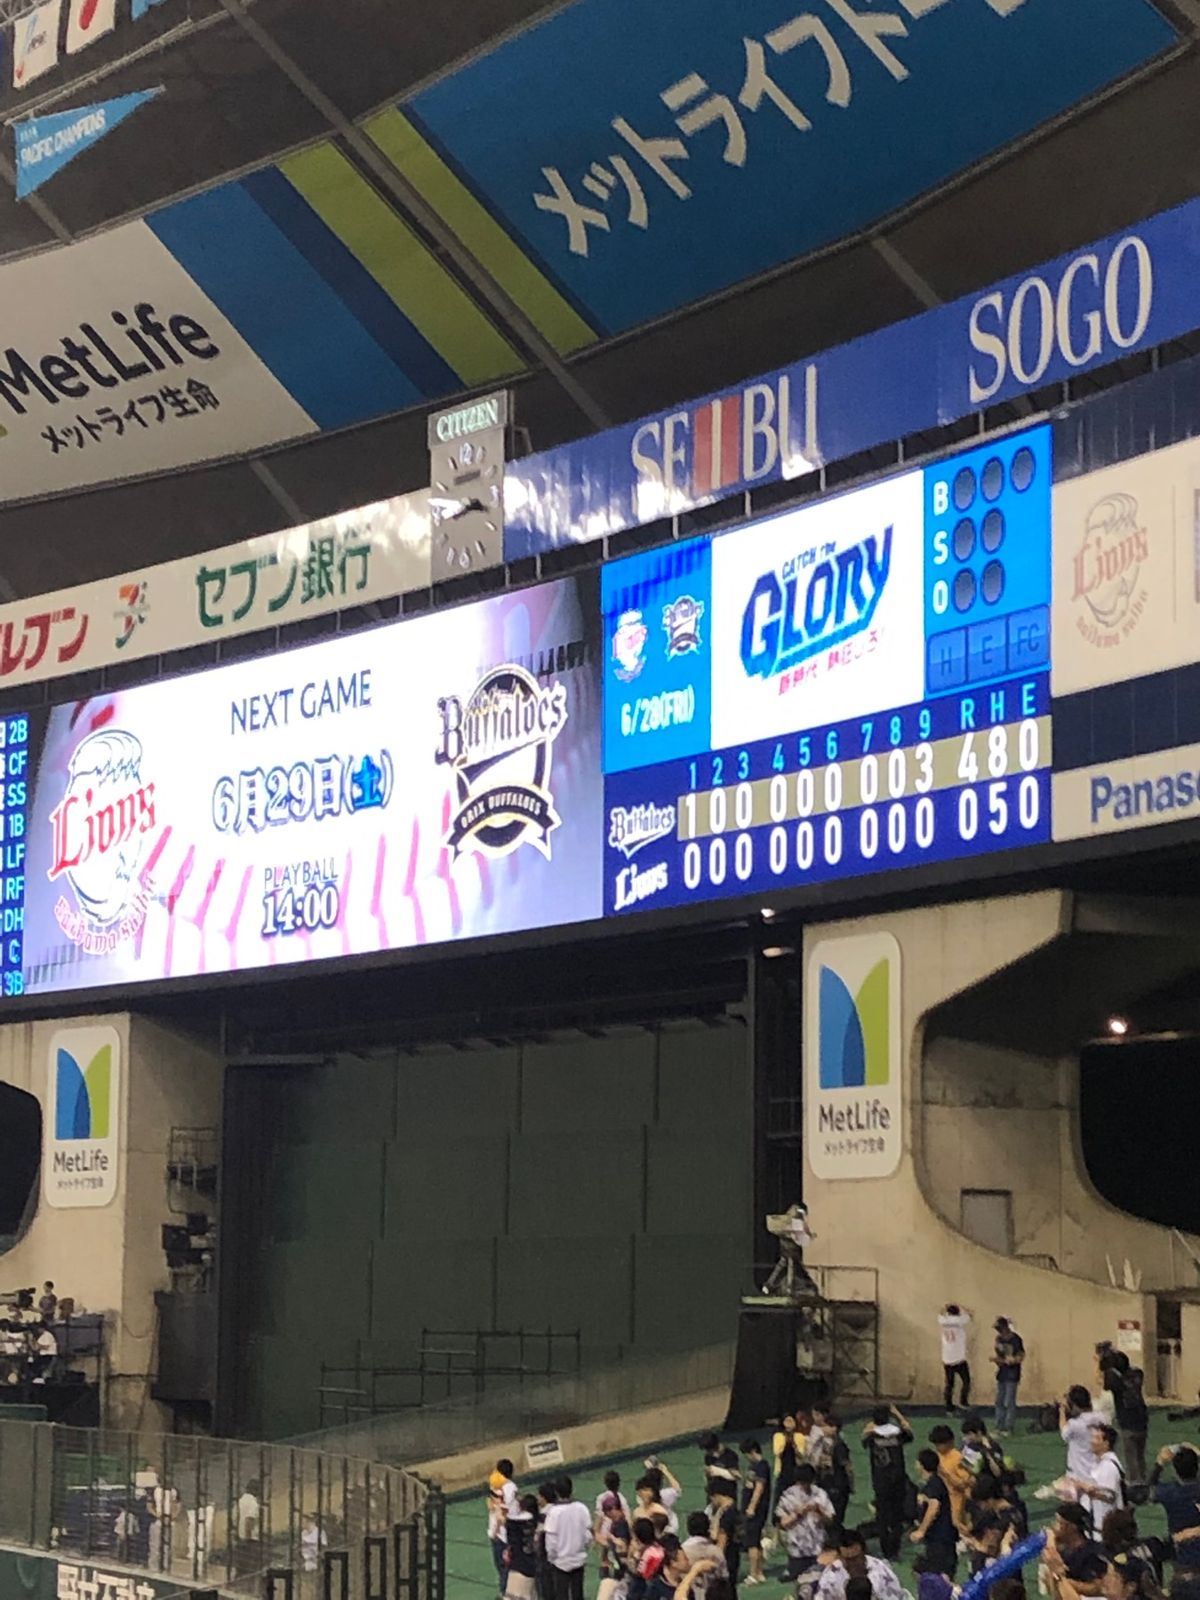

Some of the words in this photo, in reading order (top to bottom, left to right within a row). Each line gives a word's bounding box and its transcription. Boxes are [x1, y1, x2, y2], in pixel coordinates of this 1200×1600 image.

[969, 236, 1153, 403] SOGO
[0, 303, 220, 414] MetLife
[40, 378, 220, 454] メットライフ生命
[436, 399, 499, 442] CITIZEN
[631, 364, 819, 514] SEIBU
[933, 480, 949, 516] B
[933, 530, 949, 565] S
[195, 523, 372, 628] セブン銀行
[739, 523, 894, 680] GLORY
[933, 579, 949, 615] O
[0, 607, 89, 675] レブン
[1017, 622, 1041, 657] FC
[231, 687, 294, 735] NEXT
[300, 669, 372, 719] GAME
[435, 680, 566, 766] Buffaloes
[9, 718, 28, 745] 2B
[689, 762, 697, 790] 1
[712, 757, 723, 785] 2
[737, 751, 749, 779] 3
[772, 743, 785, 772] 4
[799, 737, 810, 766] 5
[826, 730, 838, 760] 6
[861, 722, 873, 752] 7
[890, 715, 901, 745] 8
[919, 708, 931, 739] 9
[961, 698, 975, 730] R
[990, 690, 1005, 723] H
[1022, 682, 1036, 715] E
[9, 750, 28, 776] CF
[685, 793, 696, 839] 1
[709, 787, 726, 834] 0
[736, 781, 753, 829] 0
[770, 775, 787, 822] 0
[797, 769, 814, 817] 0
[825, 763, 842, 812] 0
[860, 754, 878, 804] 0
[888, 748, 906, 799] 0
[915, 742, 933, 793] 3
[958, 732, 978, 783] 4
[988, 725, 1008, 778] 8
[1019, 718, 1039, 771] 0
[8, 782, 26, 805] SS
[212, 749, 394, 836] 6月29日(土)
[1091, 769, 1200, 823] Panas
[9, 813, 25, 837] 1B
[50, 782, 156, 878] Lions
[684, 843, 700, 889] 0
[709, 838, 726, 885] 0
[735, 833, 753, 880] 0
[770, 826, 787, 875] 0
[797, 821, 814, 869] 0
[824, 816, 842, 865] 0
[860, 808, 878, 859] 0
[888, 803, 906, 854] 0
[915, 797, 934, 848] 0
[959, 788, 978, 840] 0
[989, 782, 1008, 835] 5
[1019, 776, 1039, 829] 0
[7, 844, 25, 869] LF
[6, 876, 25, 901] RF
[261, 882, 340, 936] 14:00
[4, 907, 25, 933] DH
[818, 1098, 891, 1133] MetLife
[53, 1148, 109, 1173] MetLife
